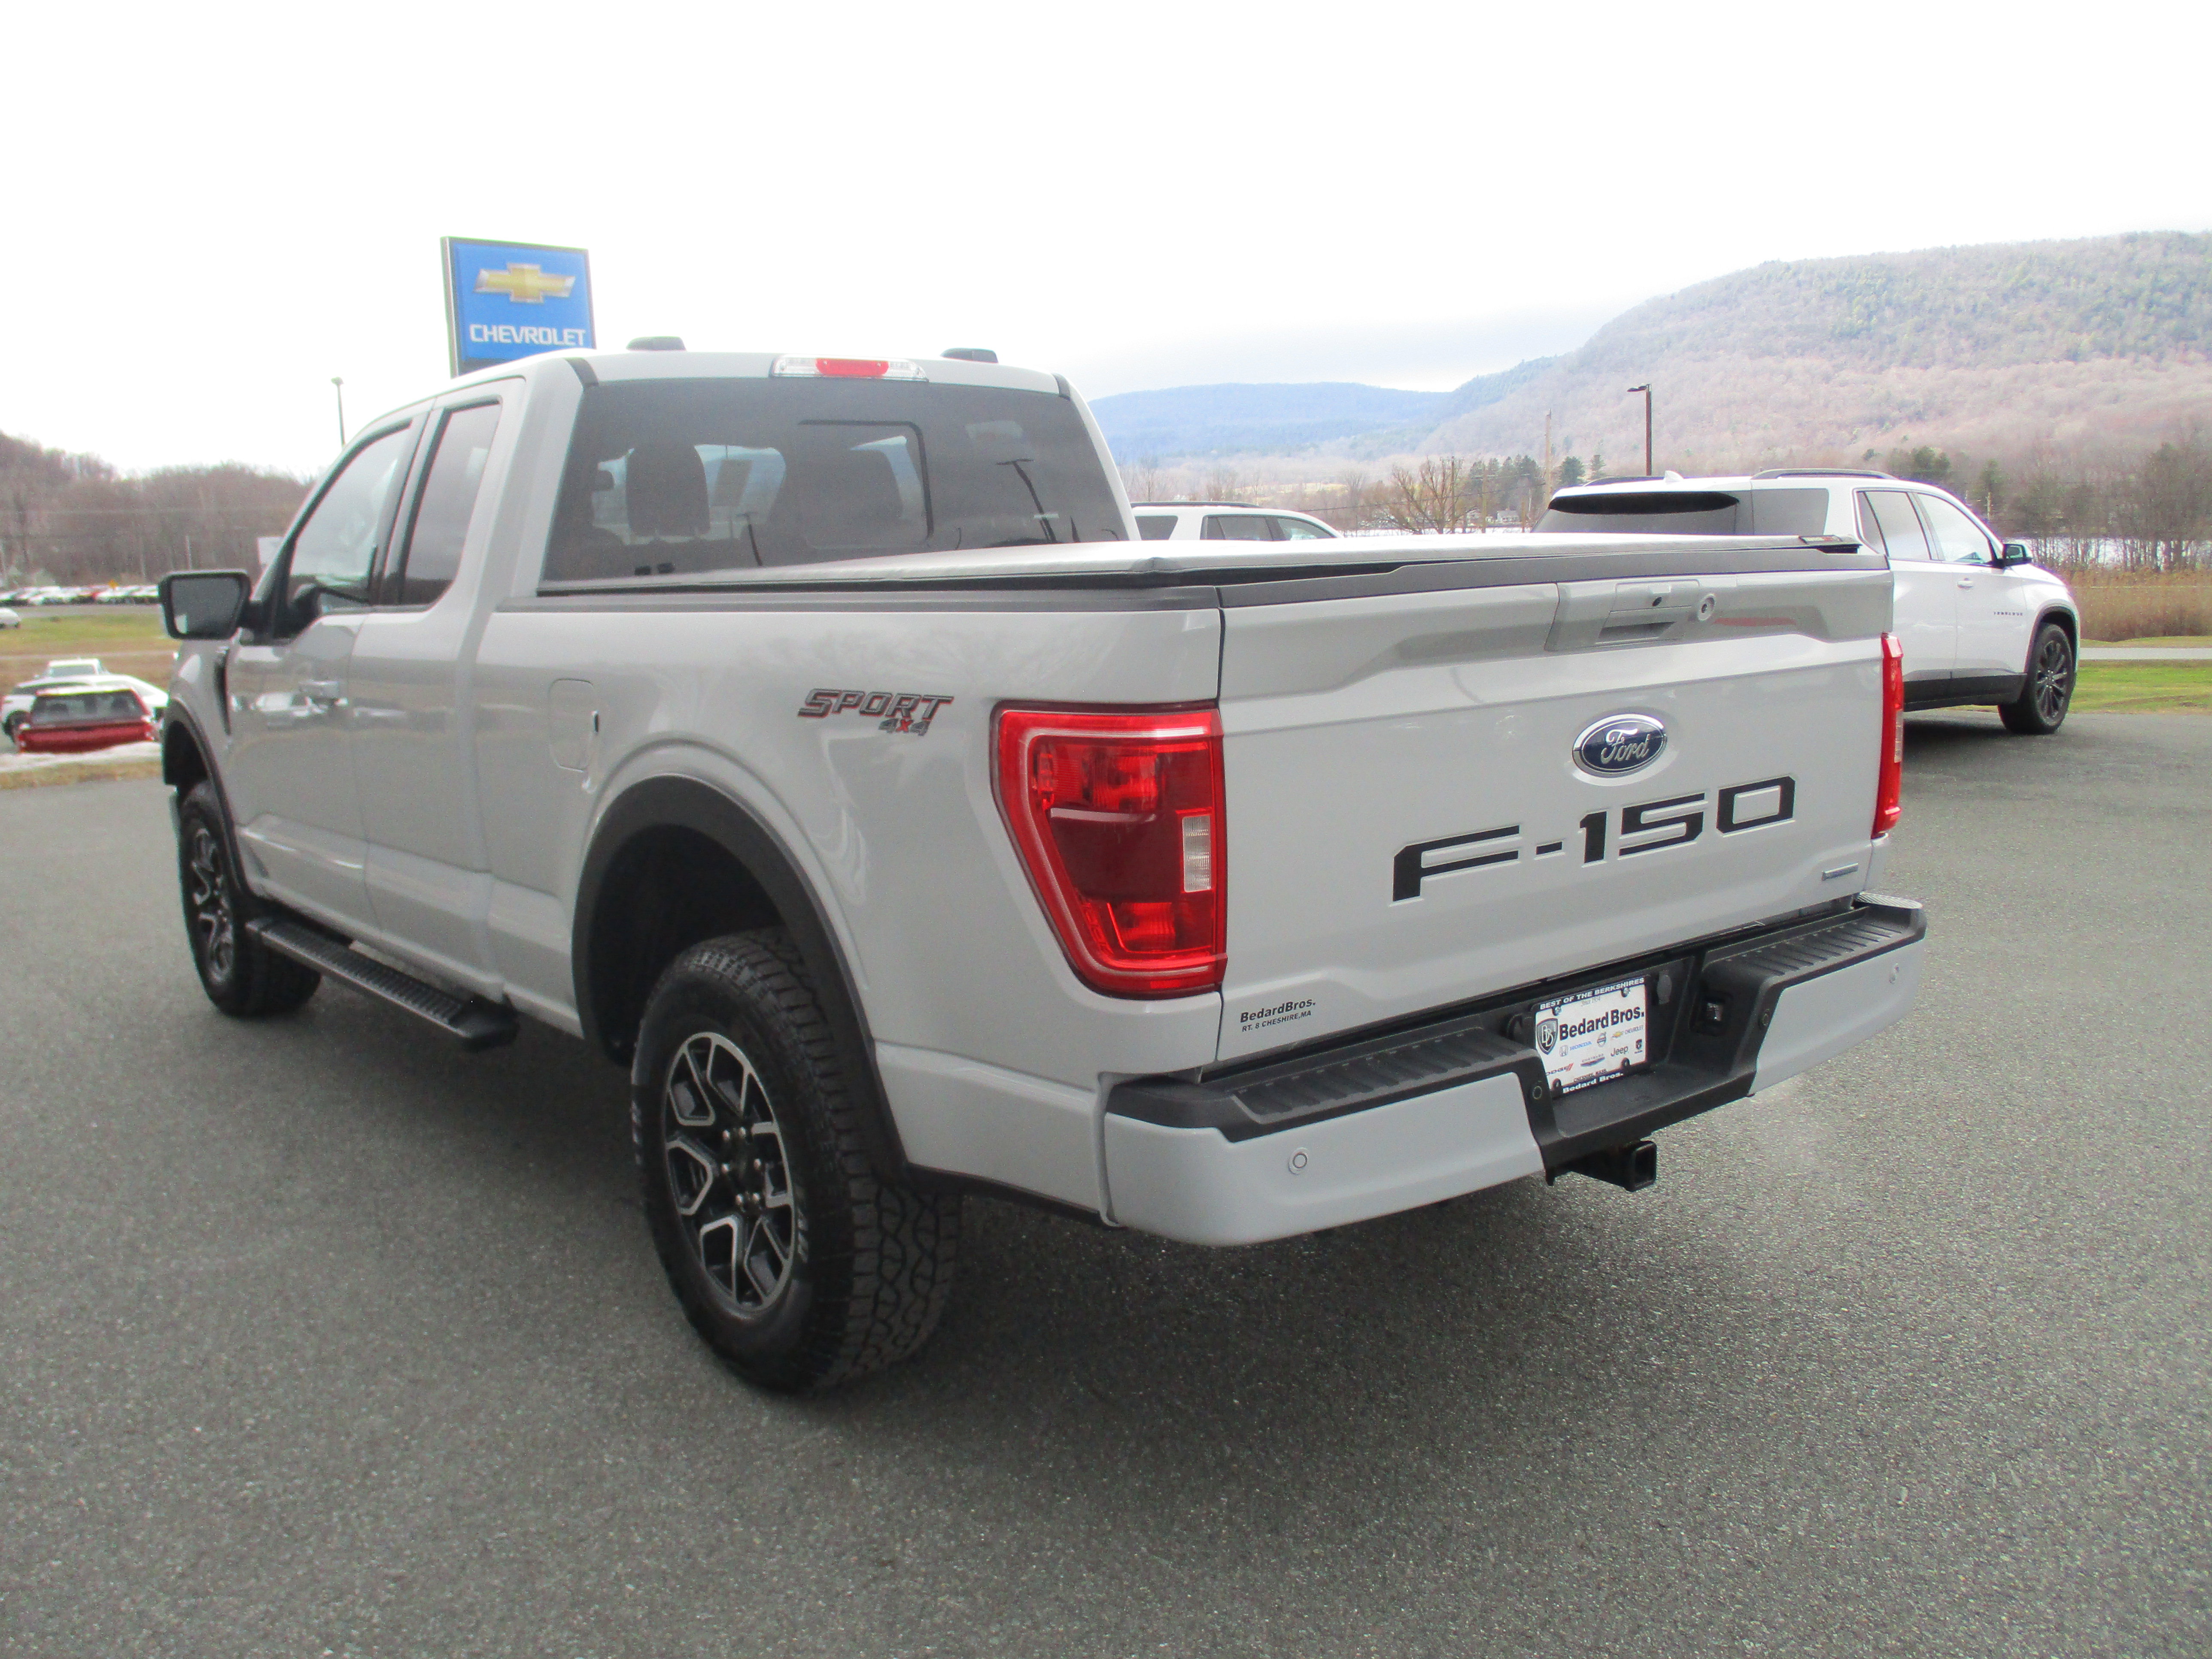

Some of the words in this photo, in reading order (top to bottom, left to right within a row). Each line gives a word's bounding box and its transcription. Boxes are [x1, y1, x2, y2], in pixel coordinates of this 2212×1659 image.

[469, 324, 586, 346] CHEVROLET
[797, 688, 954, 720] SPORT
[1601, 728, 1651, 764] Ford
[1392, 775, 1796, 902] F-150
[1540, 999, 1562, 1010] BEST
[1576, 990, 1592, 1000] THE
[1594, 977, 1644, 996] BERKSHIRES
[1559, 1012, 1609, 1041] Bedard
[1610, 1006, 1644, 1026] Bros.
[1570, 1040, 1592, 1051] HONDA
[1610, 1045, 1629, 1057] Jeep
[1562, 1078, 1597, 1094] Bedard
[1599, 1072, 1624, 1082] Bros.
